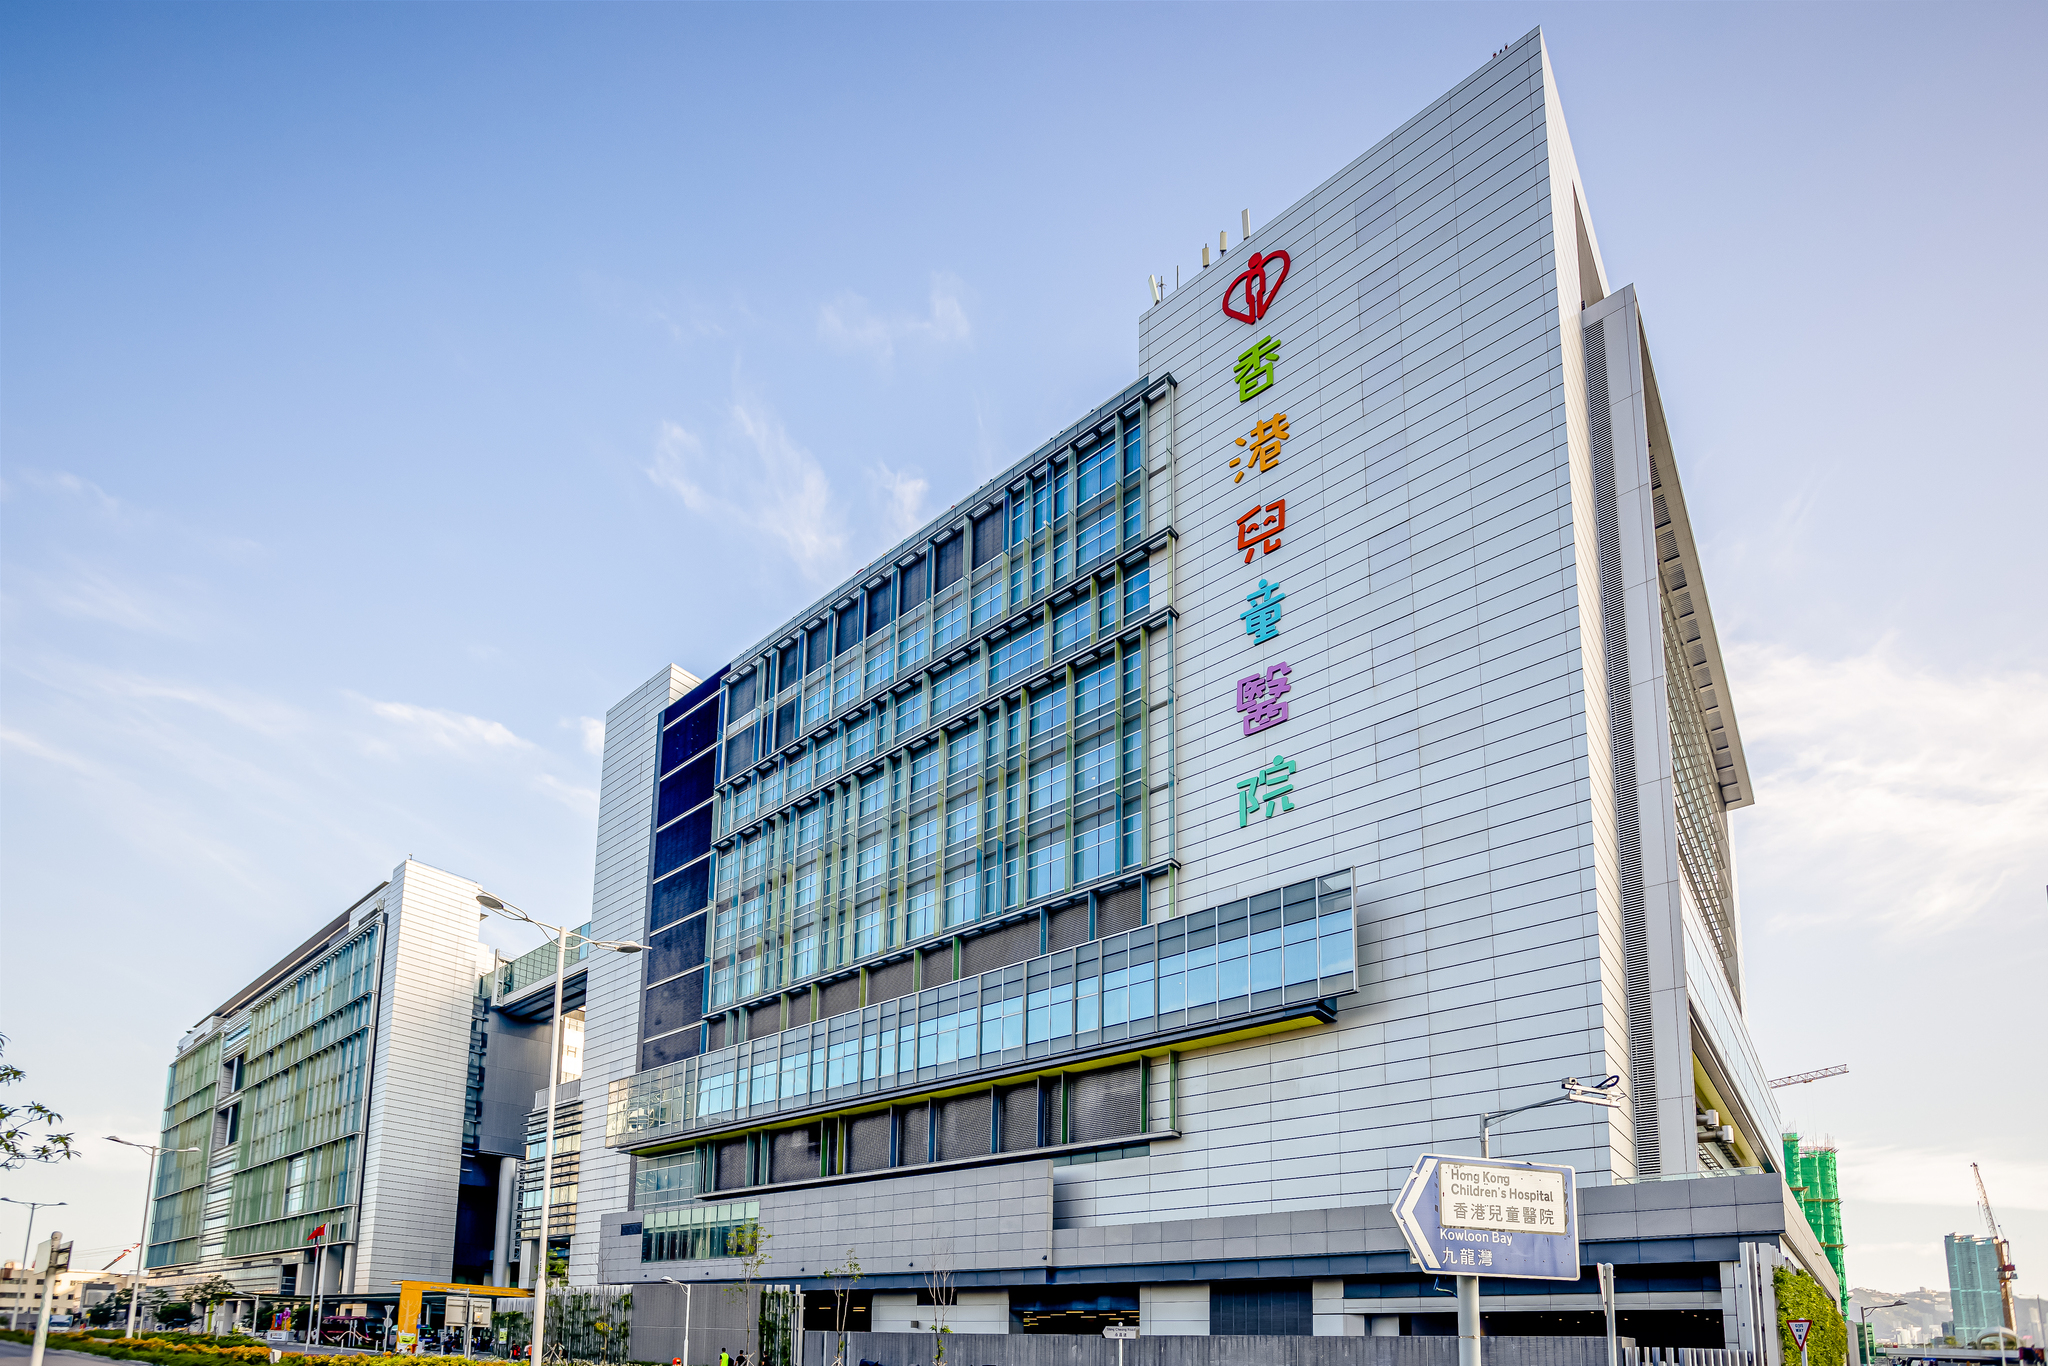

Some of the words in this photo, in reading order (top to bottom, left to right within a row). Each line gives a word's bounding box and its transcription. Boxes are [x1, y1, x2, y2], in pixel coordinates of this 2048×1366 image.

[1229, 335, 1297, 828] 香港兒童醫院
[1451, 1169, 1480, 1184] Hong
[1483, 1171, 1510, 1186] Kong
[1451, 1183, 1507, 1198] Children's
[1509, 1188, 1554, 1202] Hospital
[1453, 1202, 1555, 1225] 香港兒童醫院
[1440, 1228, 1489, 1242] Kowloon
[1491, 1231, 1513, 1246] Bay
[1442, 1246, 1493, 1267] 九龍灣
